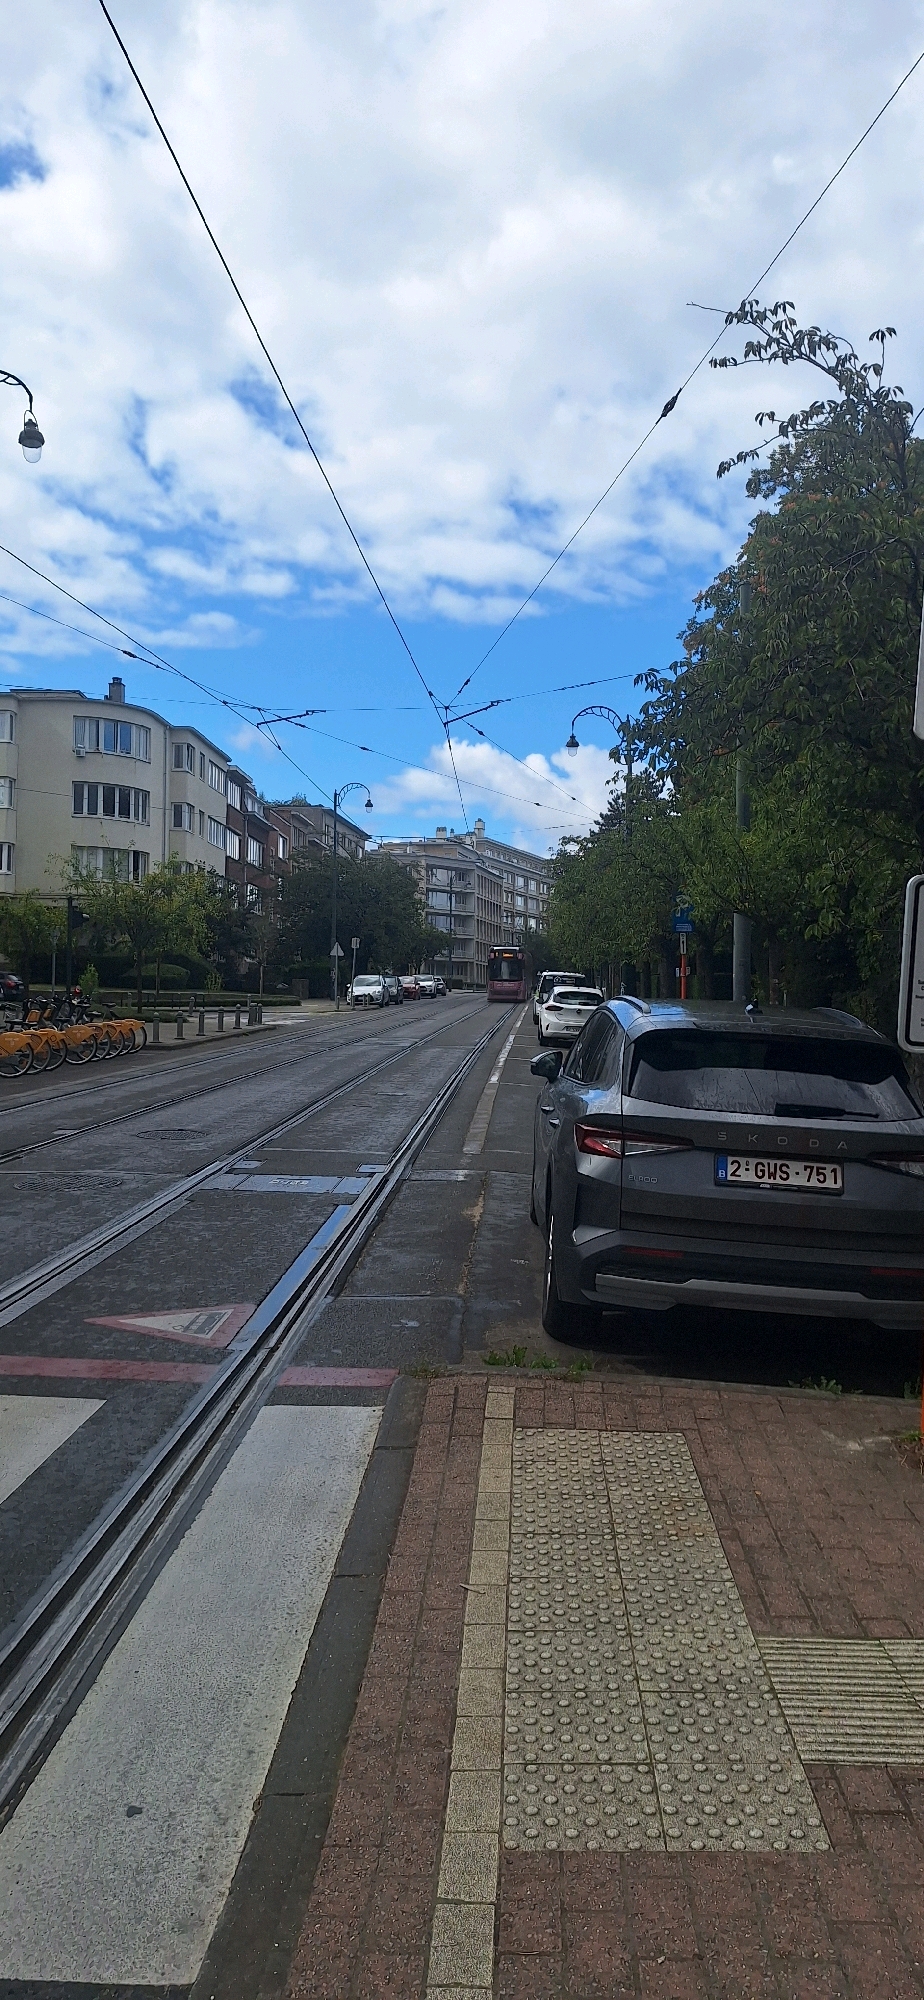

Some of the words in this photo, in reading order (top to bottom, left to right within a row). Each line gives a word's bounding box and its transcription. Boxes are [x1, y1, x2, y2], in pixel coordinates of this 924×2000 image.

[717, 1131, 848, 1150] SKODA
[628, 1174, 658, 1184] ELROQ
[718, 1170, 726, 1178] B
